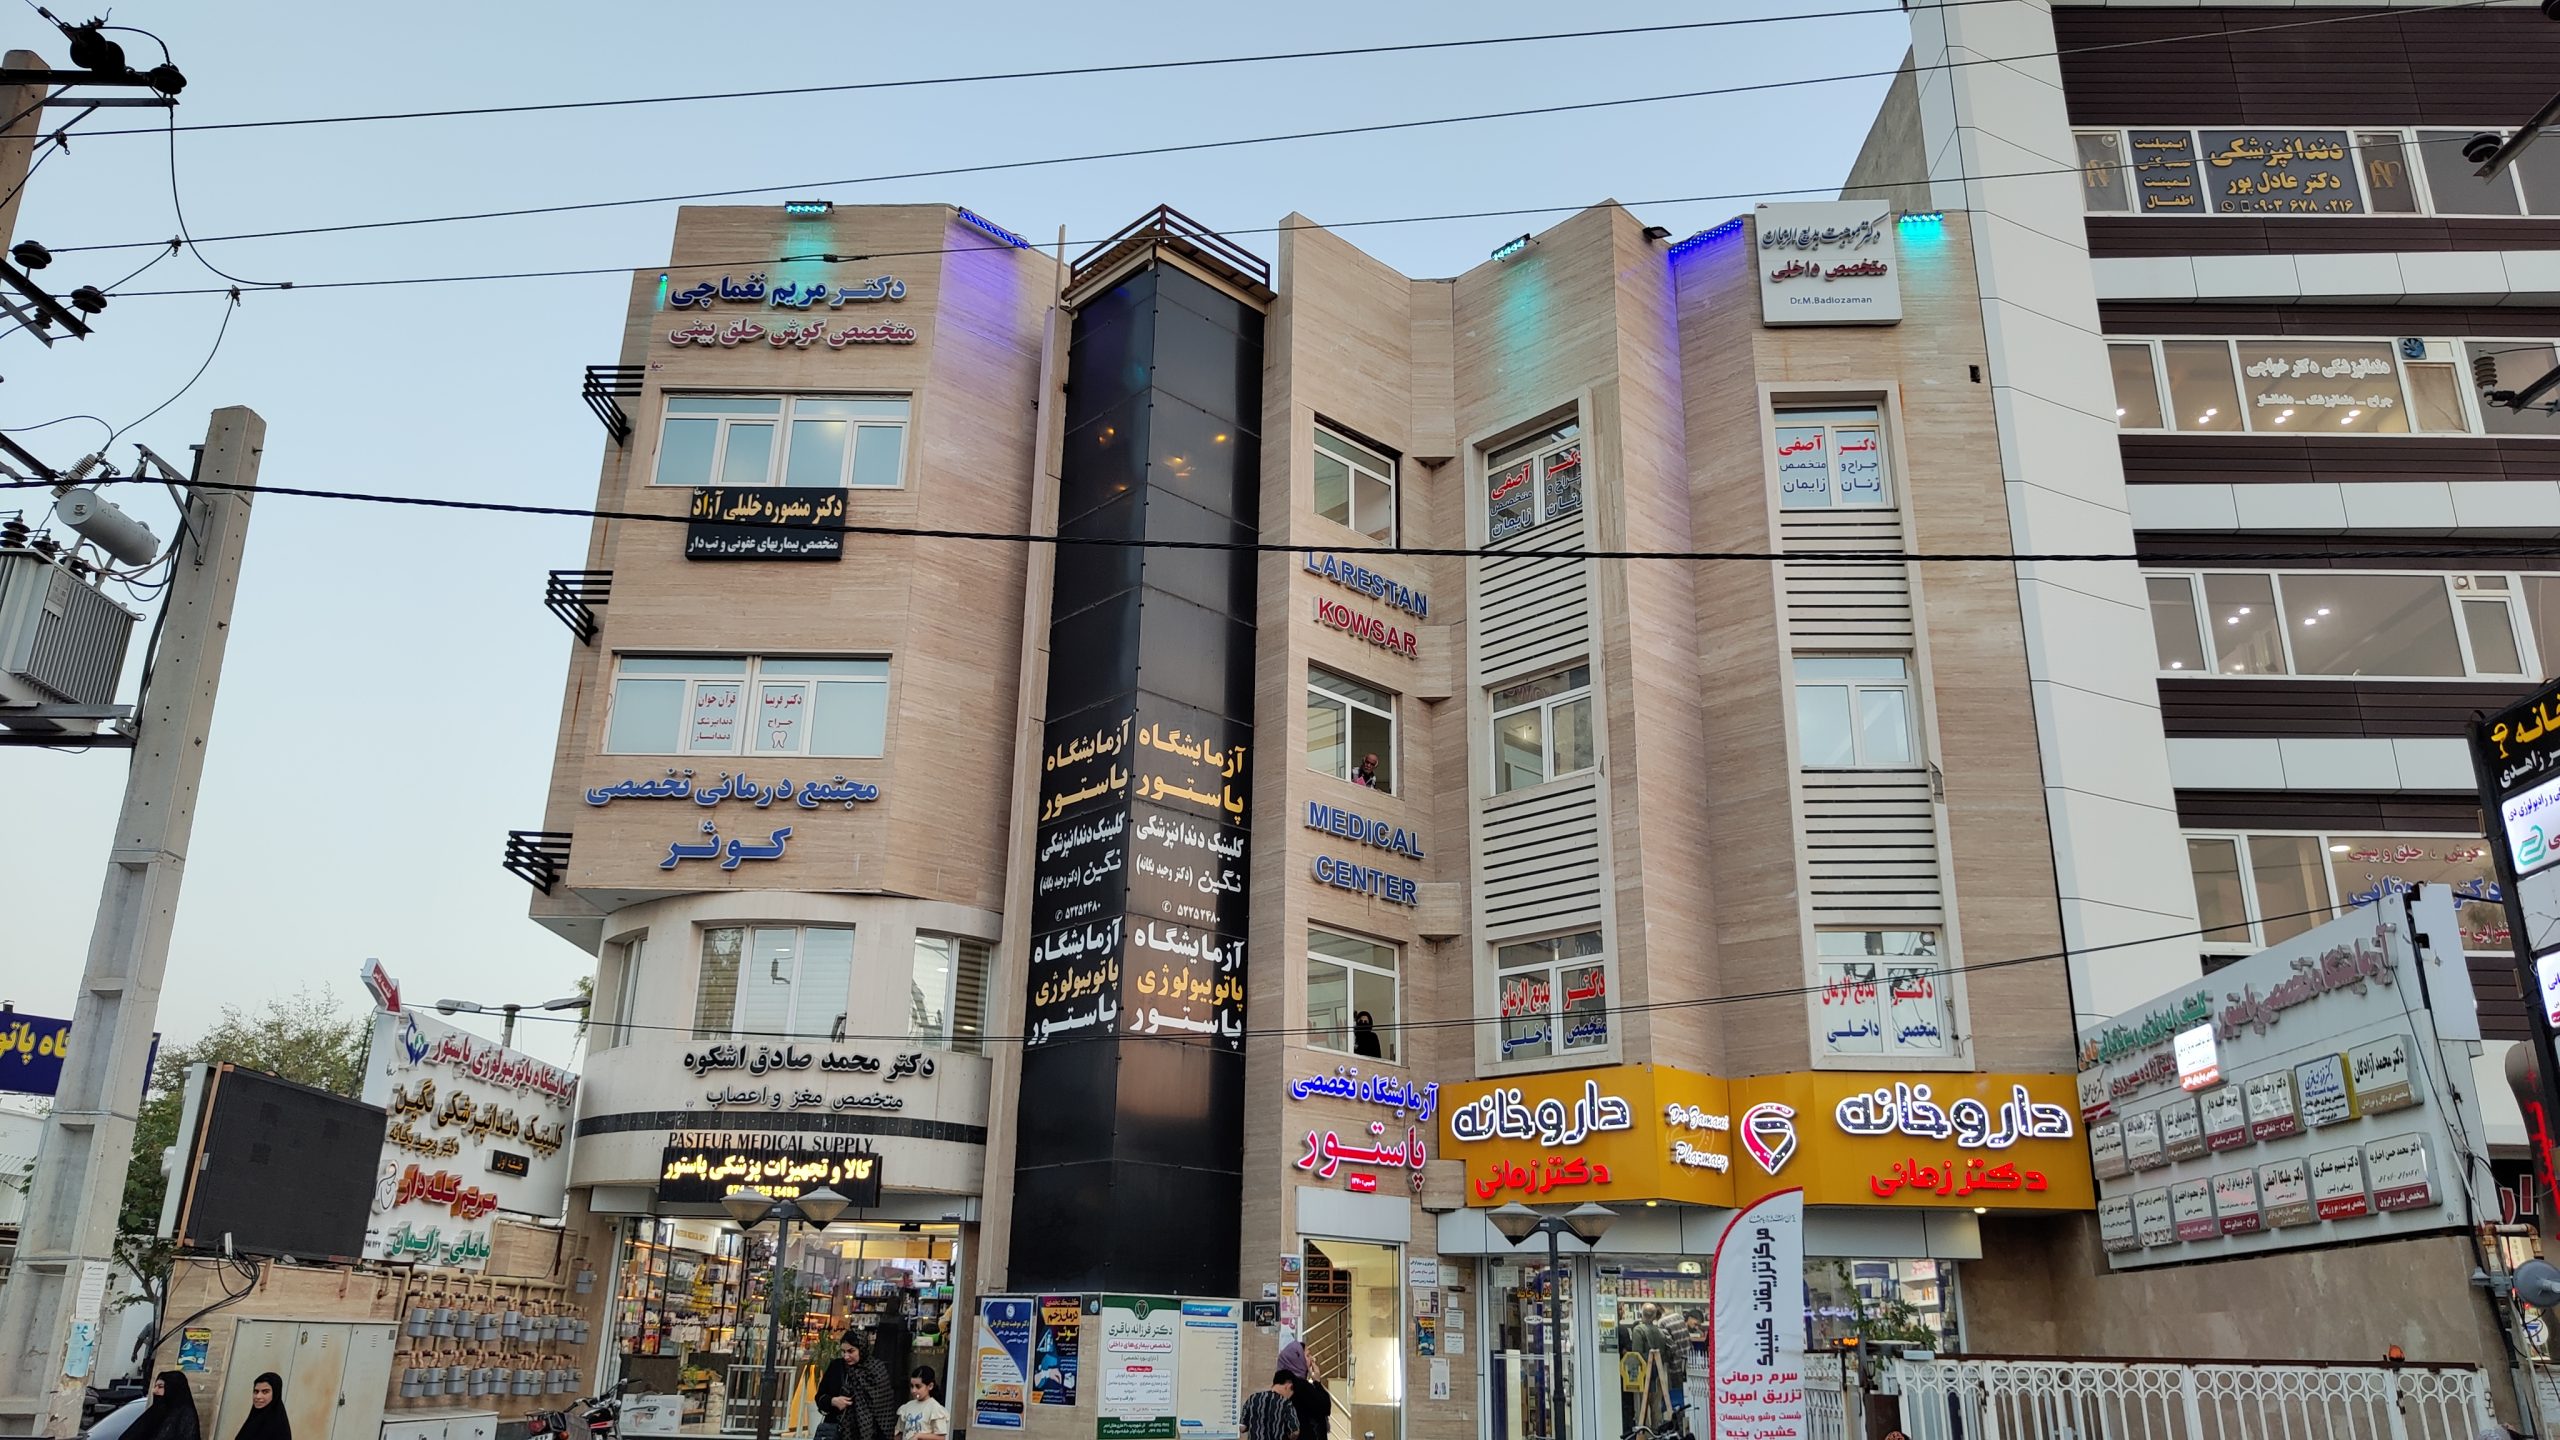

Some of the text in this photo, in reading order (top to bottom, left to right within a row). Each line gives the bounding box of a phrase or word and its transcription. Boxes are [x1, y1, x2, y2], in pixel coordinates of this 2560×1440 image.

[2134, 137, 2188, 152] ایمپلنت
[2209, 136, 2346, 168] دندانپزشکی
[2143, 174, 2191, 189] لمینت
[2226, 171, 2342, 196] دکتر عادل پور
[2146, 194, 2195, 209] اطفال
[2289, 199, 2319, 213] ۶۷۸
[1769, 258, 1888, 283] متخصص داخلی
[769, 274, 906, 308] دکتر مریم
[669, 318, 916, 348] متخصص گوش حلق بینی
[2291, 357, 2391, 379] دندانپزشکی دکتر
[1778, 434, 1878, 456] دکتر آصفی
[1490, 461, 1532, 499] آصفی
[1780, 459, 1878, 474] جراح و متخصص
[1783, 476, 1880, 494] زنان زایمان
[692, 490, 724, 519] آزاد
[765, 497, 811, 524] منصوره
[812, 495, 843, 525] دکتر
[1490, 490, 1534, 517] متخصص
[1491, 507, 1532, 538] زایمان
[720, 542, 726, 551] و
[727, 536, 756, 552] عفونی
[800, 536, 838, 553] متخصص
[1306, 550, 1428, 618] LARESTAN
[1317, 596, 1418, 657] KOWSAR
[784, 694, 802, 708] دکتر
[1047, 716, 1133, 771] آزمایشگاه
[1138, 722, 1247, 778] آزمایشگاه
[2499, 749, 2546, 789] زاهدی
[585, 768, 879, 811] مجتمع درمانی تخصصی
[1041, 763, 1129, 821] پاستور
[1136, 772, 1244, 826] پاستور
[658, 820, 793, 870] کوثر
[1041, 810, 1126, 862] کلینیک دندانپزشکی
[1136, 814, 1245, 860] کلینیک دندانپزشکی
[1307, 800, 1426, 859] MEDICAL
[1083, 848, 1122, 887] نگین
[2393, 843, 2424, 864] حلق
[1197, 869, 1242, 896] نگین
[1314, 854, 1418, 906] CENTER
[1033, 915, 1123, 964] آزمایشگاه
[1134, 921, 1246, 973] آزمایشگاه
[1035, 956, 1119, 1007] پاتوبیولوژی
[1137, 963, 1243, 1012] پاتوبیولوژی
[1564, 967, 1606, 1011] دکتر
[1027, 993, 1118, 1046] پاستور
[1129, 1006, 1243, 1049] پاستور
[1502, 1015, 1608, 1055] متخصص داخلی
[1827, 1018, 1939, 1044] متخصص داخلی
[431, 1034, 471, 1074] پاستور
[684, 1045, 936, 1082] دکتر محمد صادق اشکوه
[2375, 1054, 2392, 1071] محمد
[2392, 1046, 2405, 1072] دکتر
[470, 1048, 532, 1095] پاتوبیولوژی
[530, 1070, 580, 1108] آزمایشگاه
[706, 1085, 904, 1112] متخصص مغز و اعصاب
[1292, 1065, 1440, 1121] آزمایشگاه تخصصی
[394, 1077, 566, 1153] کلینیک دندانپزشکی نگین
[1451, 1079, 1632, 1147] داروخانه
[1835, 1081, 2074, 1149] داروخانه
[668, 1132, 874, 1153] PASTEUR MEDICAL SUPPLY
[1298, 1120, 1427, 1192] پاستور
[1675, 1140, 1729, 1174] Pharmacy
[2396, 1148, 2409, 1156] محمد
[2409, 1141, 2420, 1157] دکتر
[663, 1154, 873, 1184] کالا و تجهیزات پزشکی پاستور
[1475, 1156, 1612, 1200] دکتر زمانی
[1870, 1157, 2049, 1198] دکتر زمانی
[2293, 1166, 2304, 1187] دکتر
[2346, 1155, 2359, 1173] دکتر
[399, 1163, 498, 1218] مریم گله دار
[390, 1224, 492, 1263] مامایی زایمان
[1752, 1261, 1778, 1313] تزریقات
[1055, 1326, 1079, 1342] کوثر
[1108, 1321, 1173, 1338] دکتر فرزانه باقری
[1721, 1370, 1798, 1386] سرم درمانی
[1718, 1388, 1802, 1408] تزریق امپول
[1779, 1410, 1802, 1420] شست
[1726, 1425, 1797, 1440] کشیدن بخیه
